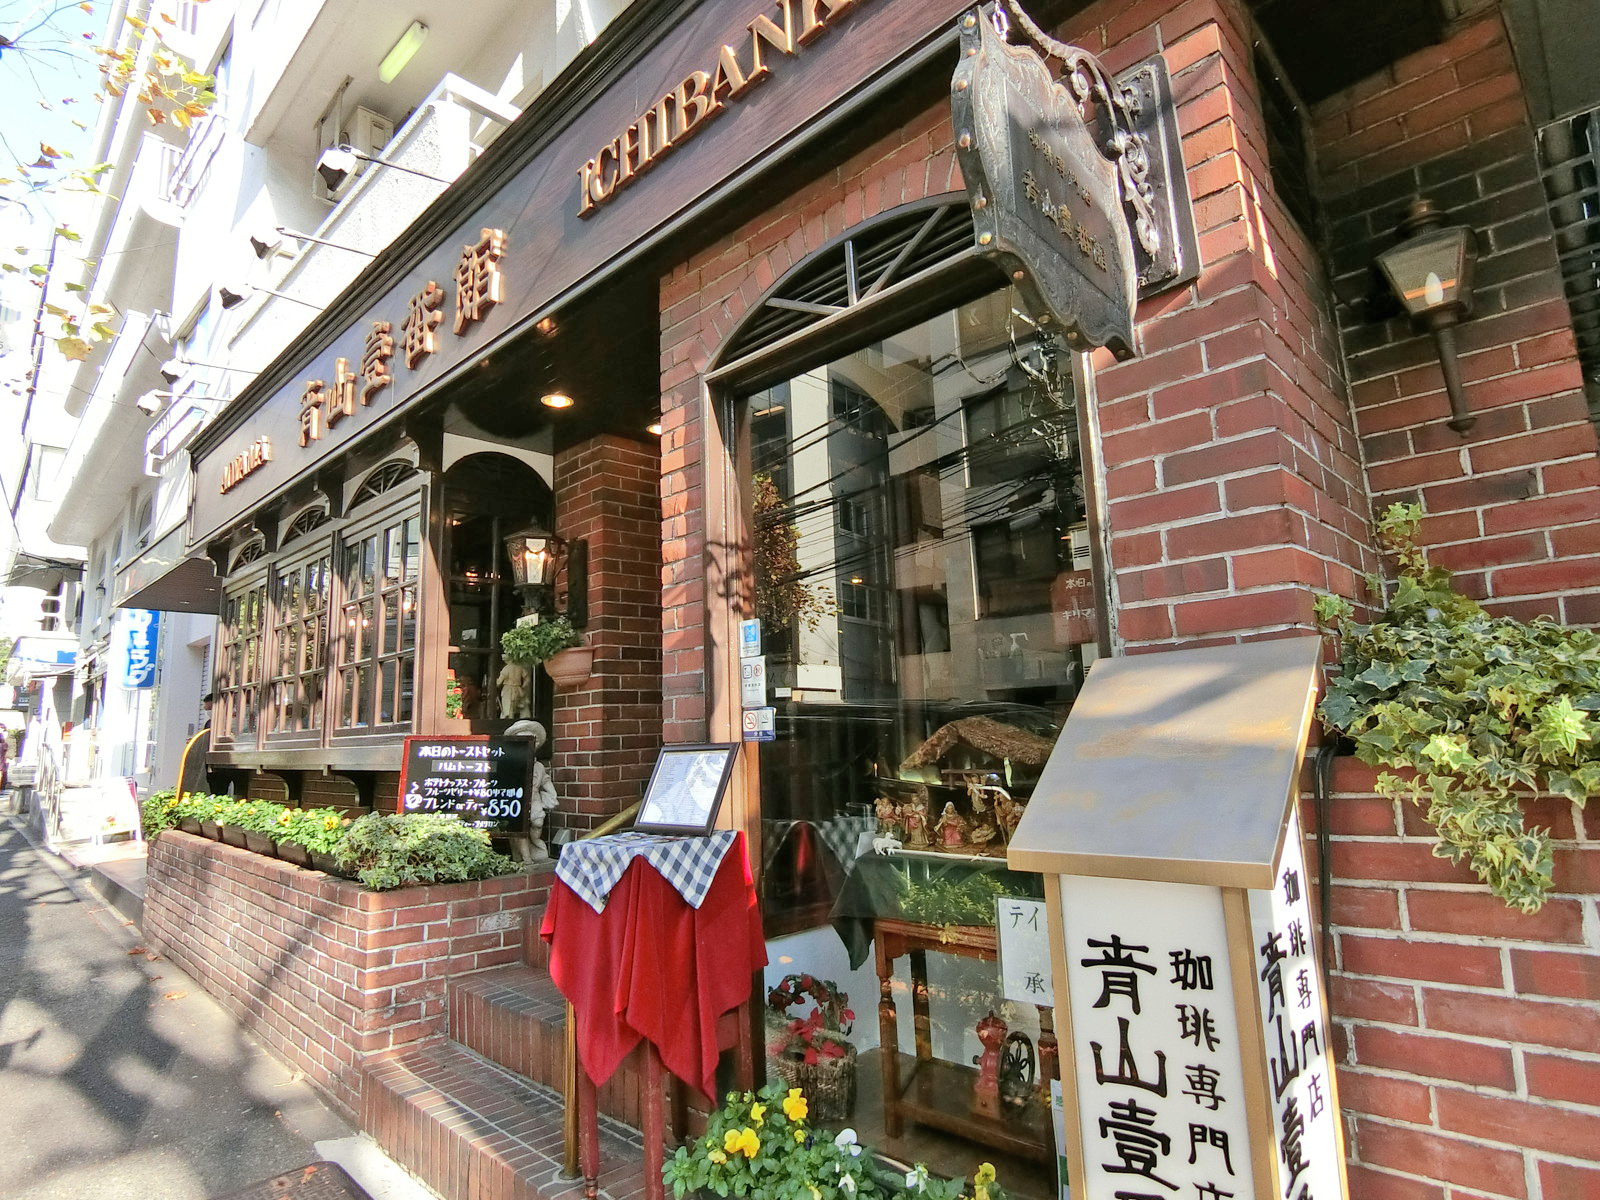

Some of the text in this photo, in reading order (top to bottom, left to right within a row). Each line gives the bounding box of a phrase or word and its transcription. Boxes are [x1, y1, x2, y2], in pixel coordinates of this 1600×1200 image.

[418, 745, 505, 757] 本日のトーストセット
[438, 761, 492, 773] ハムトースト
[1024, 971, 1046, 994] 承
[1282, 866, 1325, 1124] 珈琲専門店
[1081, 933, 1180, 1200] 青山壹
